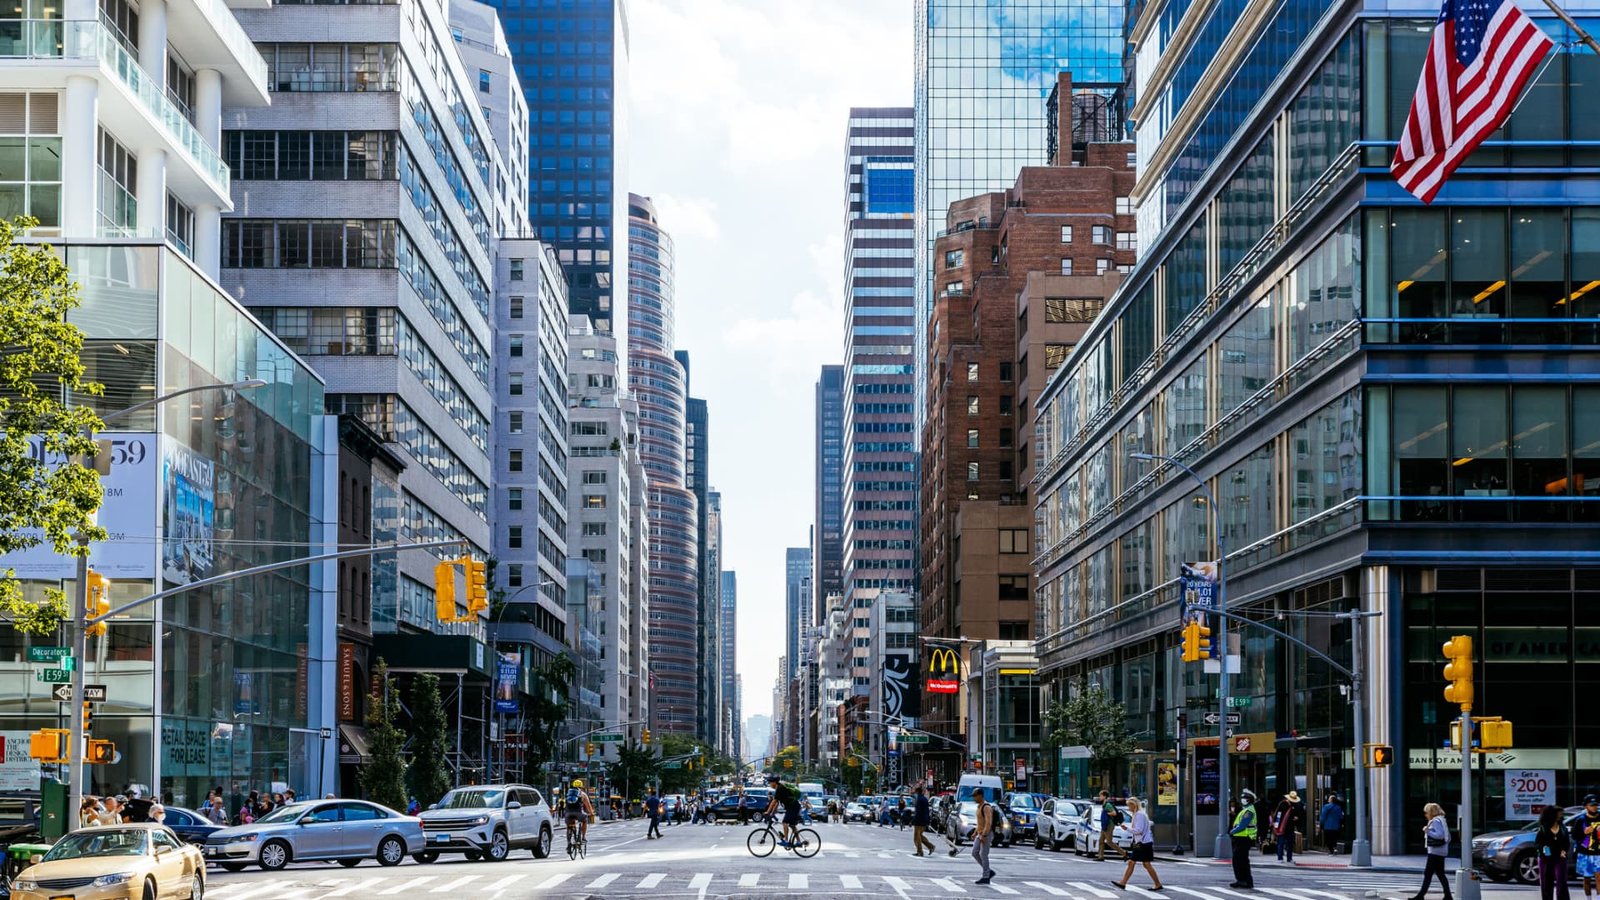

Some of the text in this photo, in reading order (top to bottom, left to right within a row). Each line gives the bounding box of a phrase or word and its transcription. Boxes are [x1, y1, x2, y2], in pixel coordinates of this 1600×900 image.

[32, 648, 67, 657] Decorators
[46, 670, 51, 681] E
[52, 670, 62, 681] 59
[162, 728, 206, 746] RETAIL SPACE
[170, 748, 184, 764] FOR
[185, 748, 206, 764] LEASE
